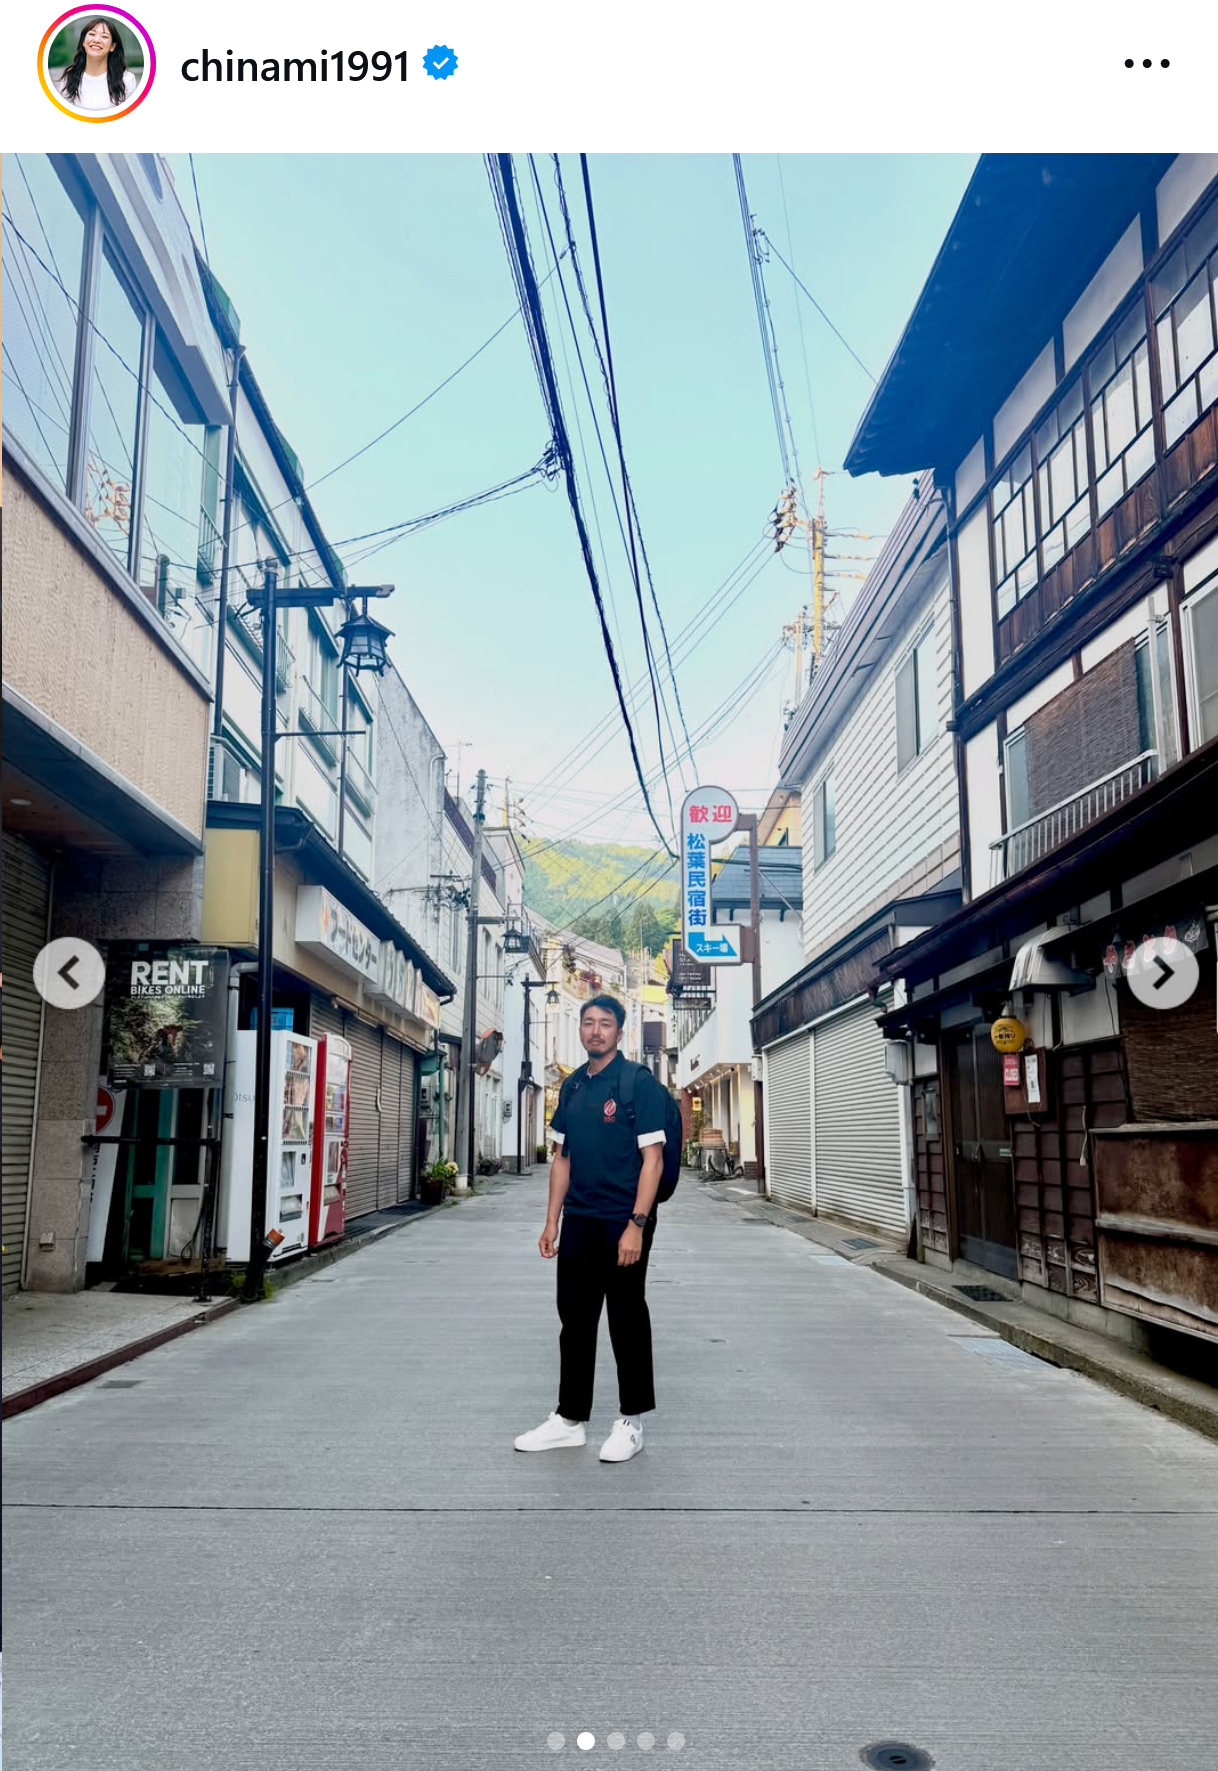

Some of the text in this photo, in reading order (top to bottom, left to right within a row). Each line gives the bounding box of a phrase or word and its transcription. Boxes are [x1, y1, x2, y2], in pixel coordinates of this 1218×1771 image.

[689, 804, 732, 823] 歓迎
[687, 832, 707, 927] 松葉民宿街
[331, 907, 377, 971] フードセンター
[130, 960, 209, 986] RENT
[130, 985, 206, 996] BIKES ONLINE
